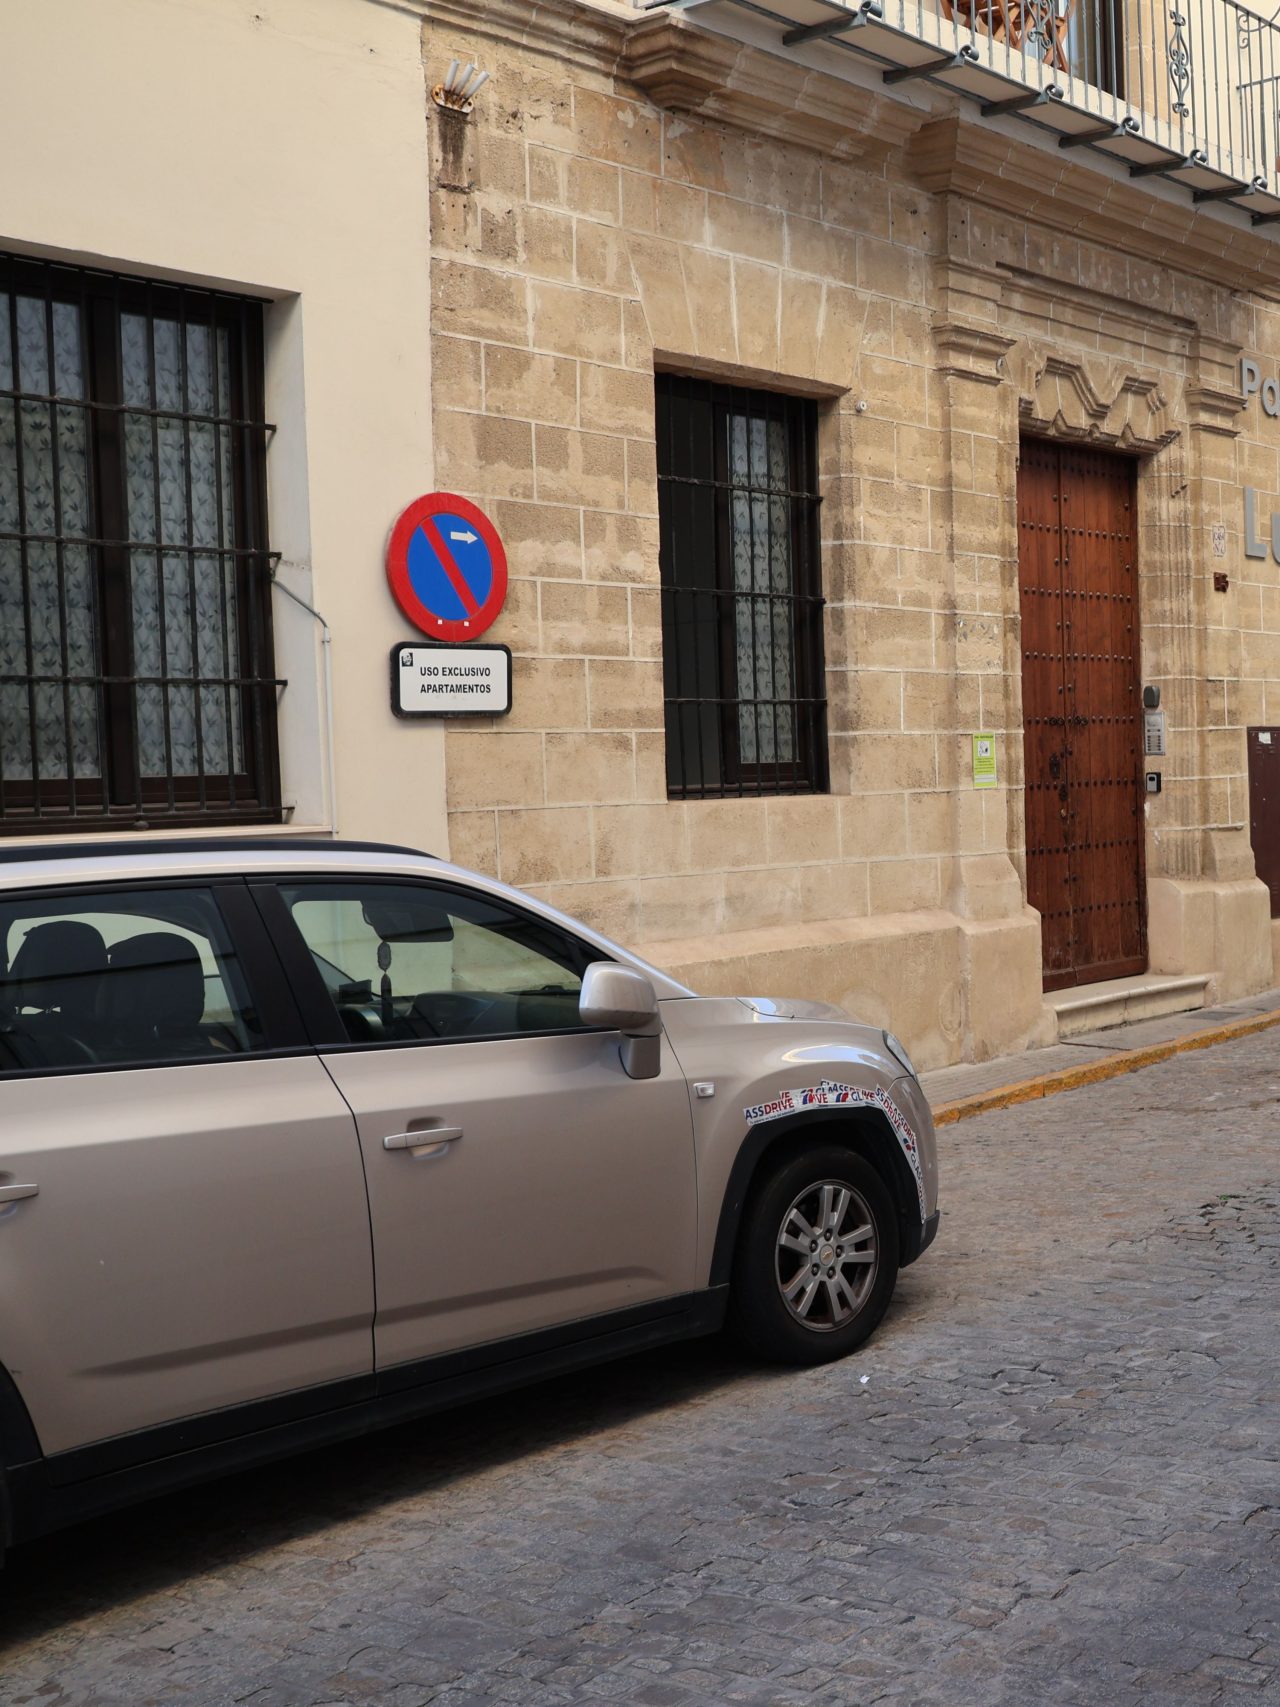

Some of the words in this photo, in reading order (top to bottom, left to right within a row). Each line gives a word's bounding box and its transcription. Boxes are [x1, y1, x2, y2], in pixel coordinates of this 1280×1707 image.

[420, 666, 439, 677] USO
[441, 666, 491, 677] EXCLUSIVO
[420, 683, 491, 694] APARTAMENTOS
